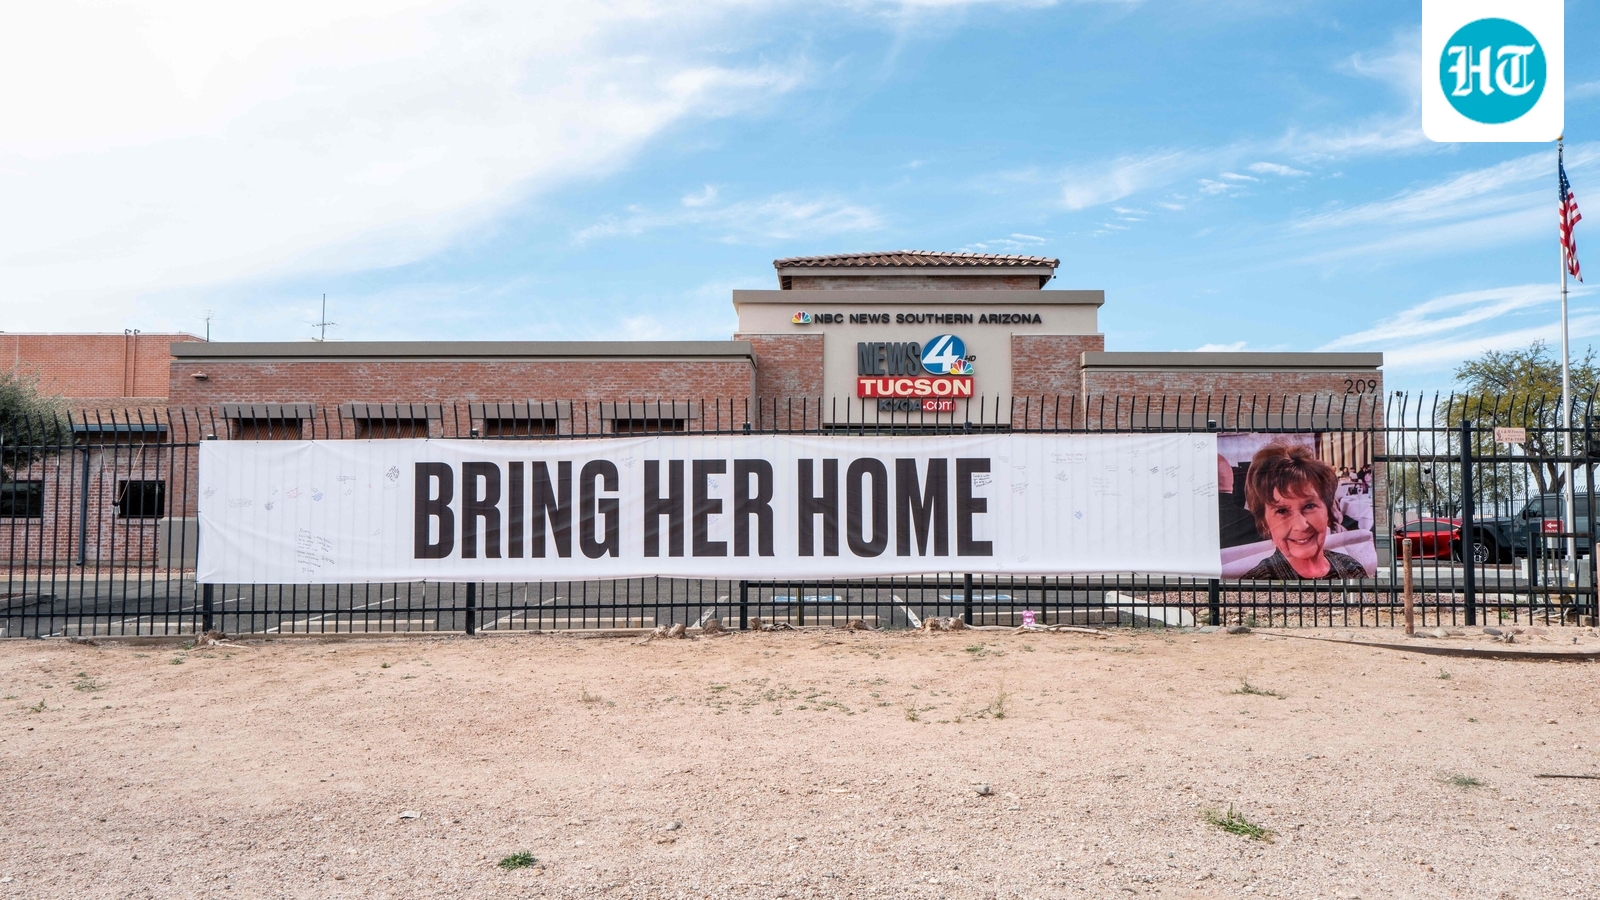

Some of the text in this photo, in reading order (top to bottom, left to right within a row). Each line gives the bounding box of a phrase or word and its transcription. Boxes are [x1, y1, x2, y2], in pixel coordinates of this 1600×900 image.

[814, 313, 1042, 324] NBC NEWS SOUTHERN ARIZONA
[857, 334, 960, 376] NEWS 4
[860, 379, 971, 396] TUCSON
[1344, 379, 1377, 394] 209
[414, 459, 620, 559] BRING
[643, 458, 775, 558] HER
[797, 457, 993, 558] HOME
